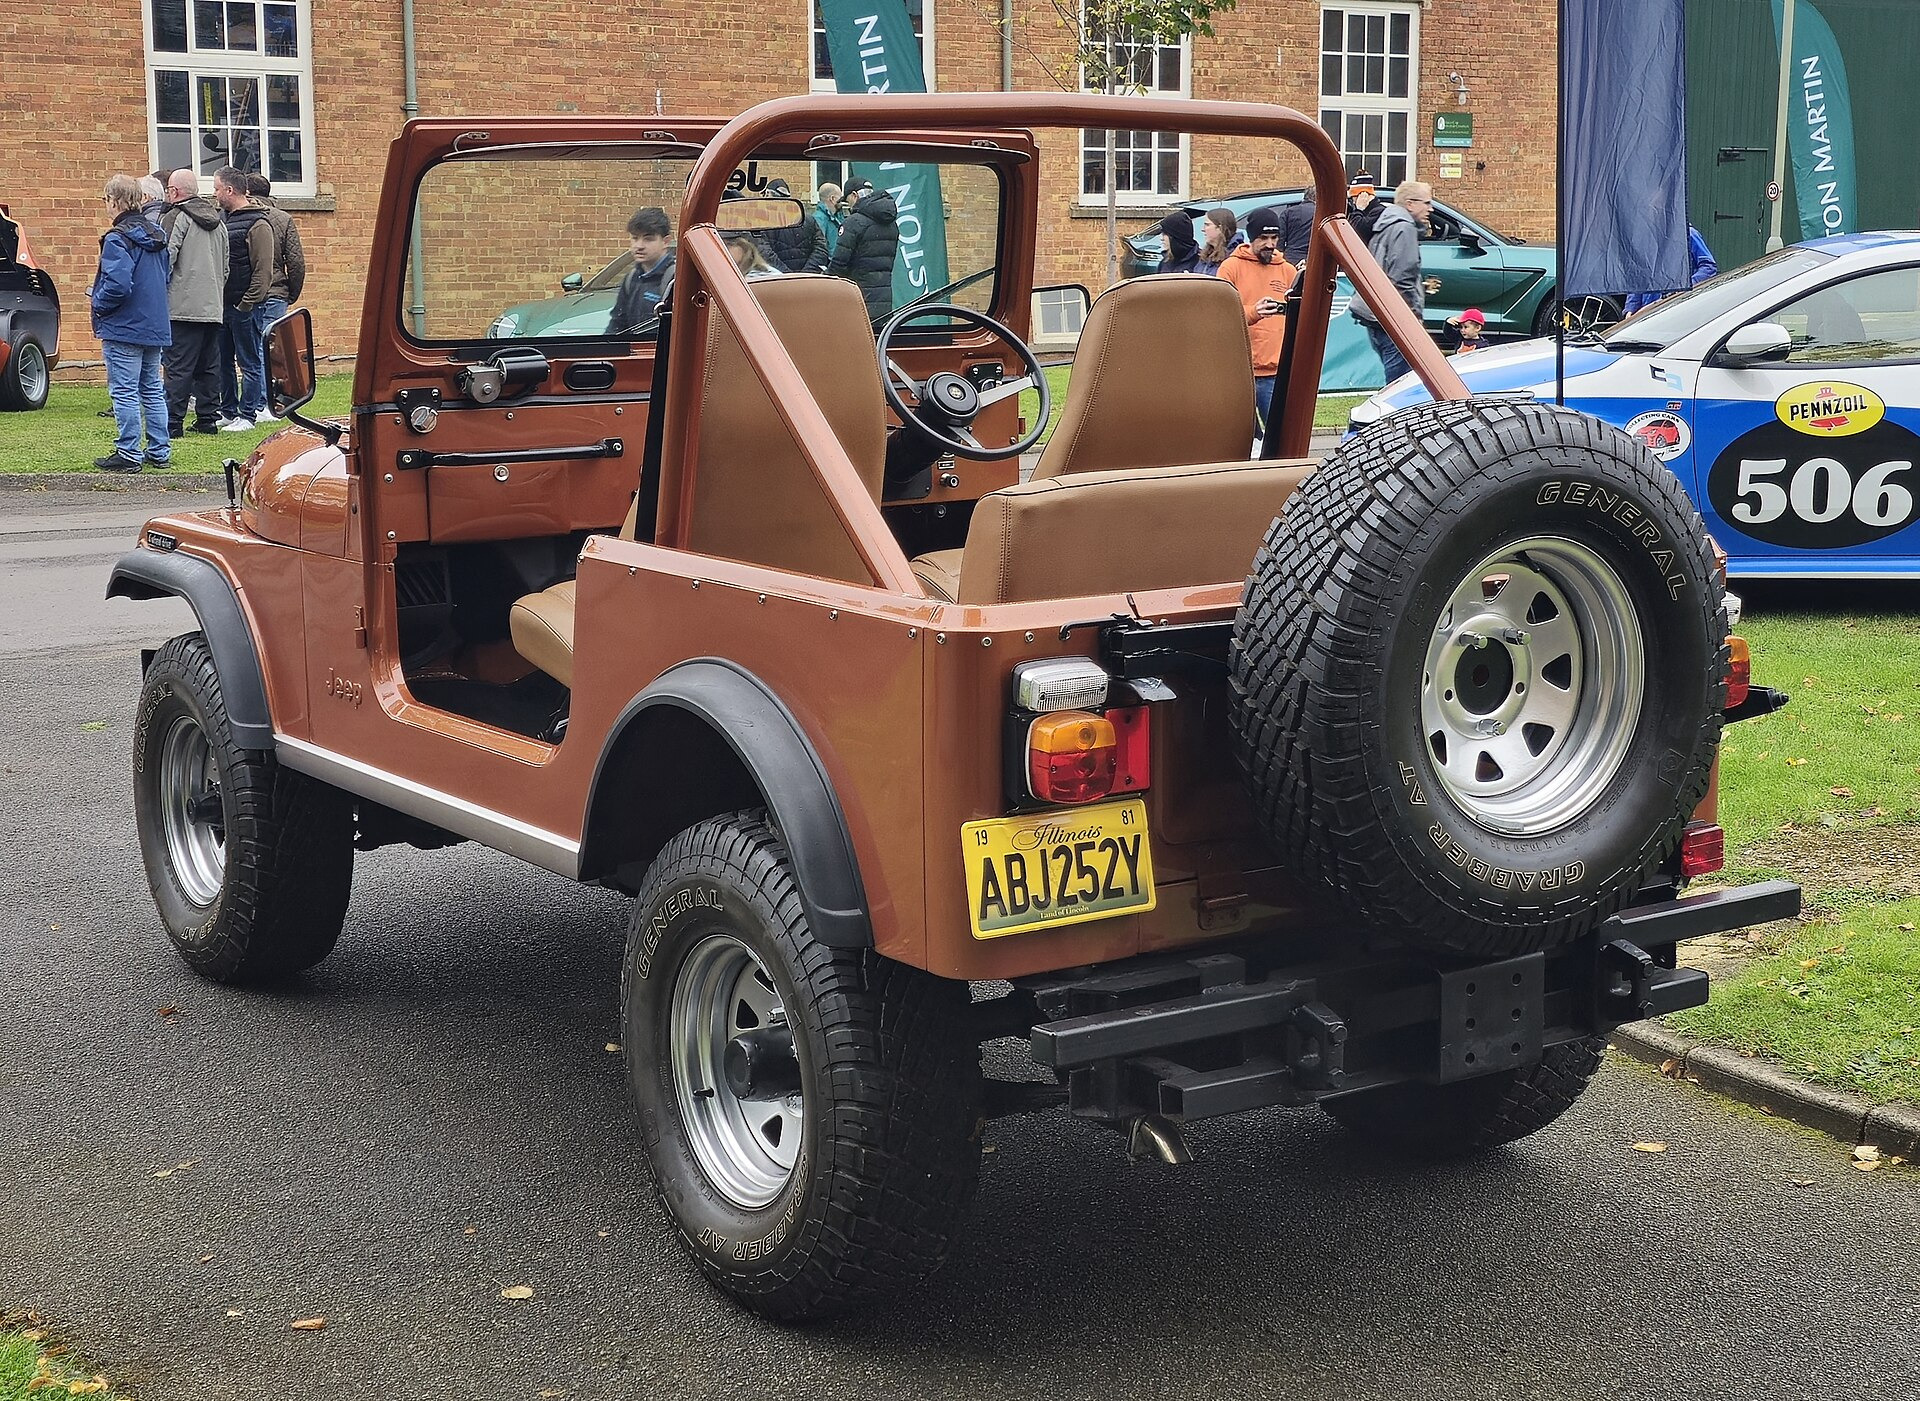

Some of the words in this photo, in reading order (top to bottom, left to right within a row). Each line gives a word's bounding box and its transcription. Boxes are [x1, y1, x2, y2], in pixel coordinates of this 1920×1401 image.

[1801, 55, 1835, 172] MARTIN
[1769, 186, 1777, 195] 20
[1817, 181, 1845, 238] TON
[886, 184, 929, 294] STON
[1626, 412, 1661, 432] COLLECTING
[1661, 413, 1680, 423] CARS
[1790, 394, 1868, 421] PENNZOIL
[1732, 457, 1913, 527] 506
[1536, 481, 1687, 601] GENERAL
[325, 667, 363, 710] Jeep
[135, 680, 174, 773] GENERAL
[1397, 761, 1428, 806] AT
[975, 829, 988, 847] 19
[1121, 809, 1135, 825] 81
[1011, 823, 1103, 851] Illinois
[1428, 820, 1585, 891] GRABBER
[978, 834, 1142, 920] ABJ252Y
[636, 887, 724, 980] GENERAL
[1040, 909, 1058, 919] Land
[1056, 908, 1065, 918] of
[1064, 905, 1090, 916] Lincoln
[733, 1153, 810, 1261] GRABBER
[697, 1226, 727, 1253] AT
